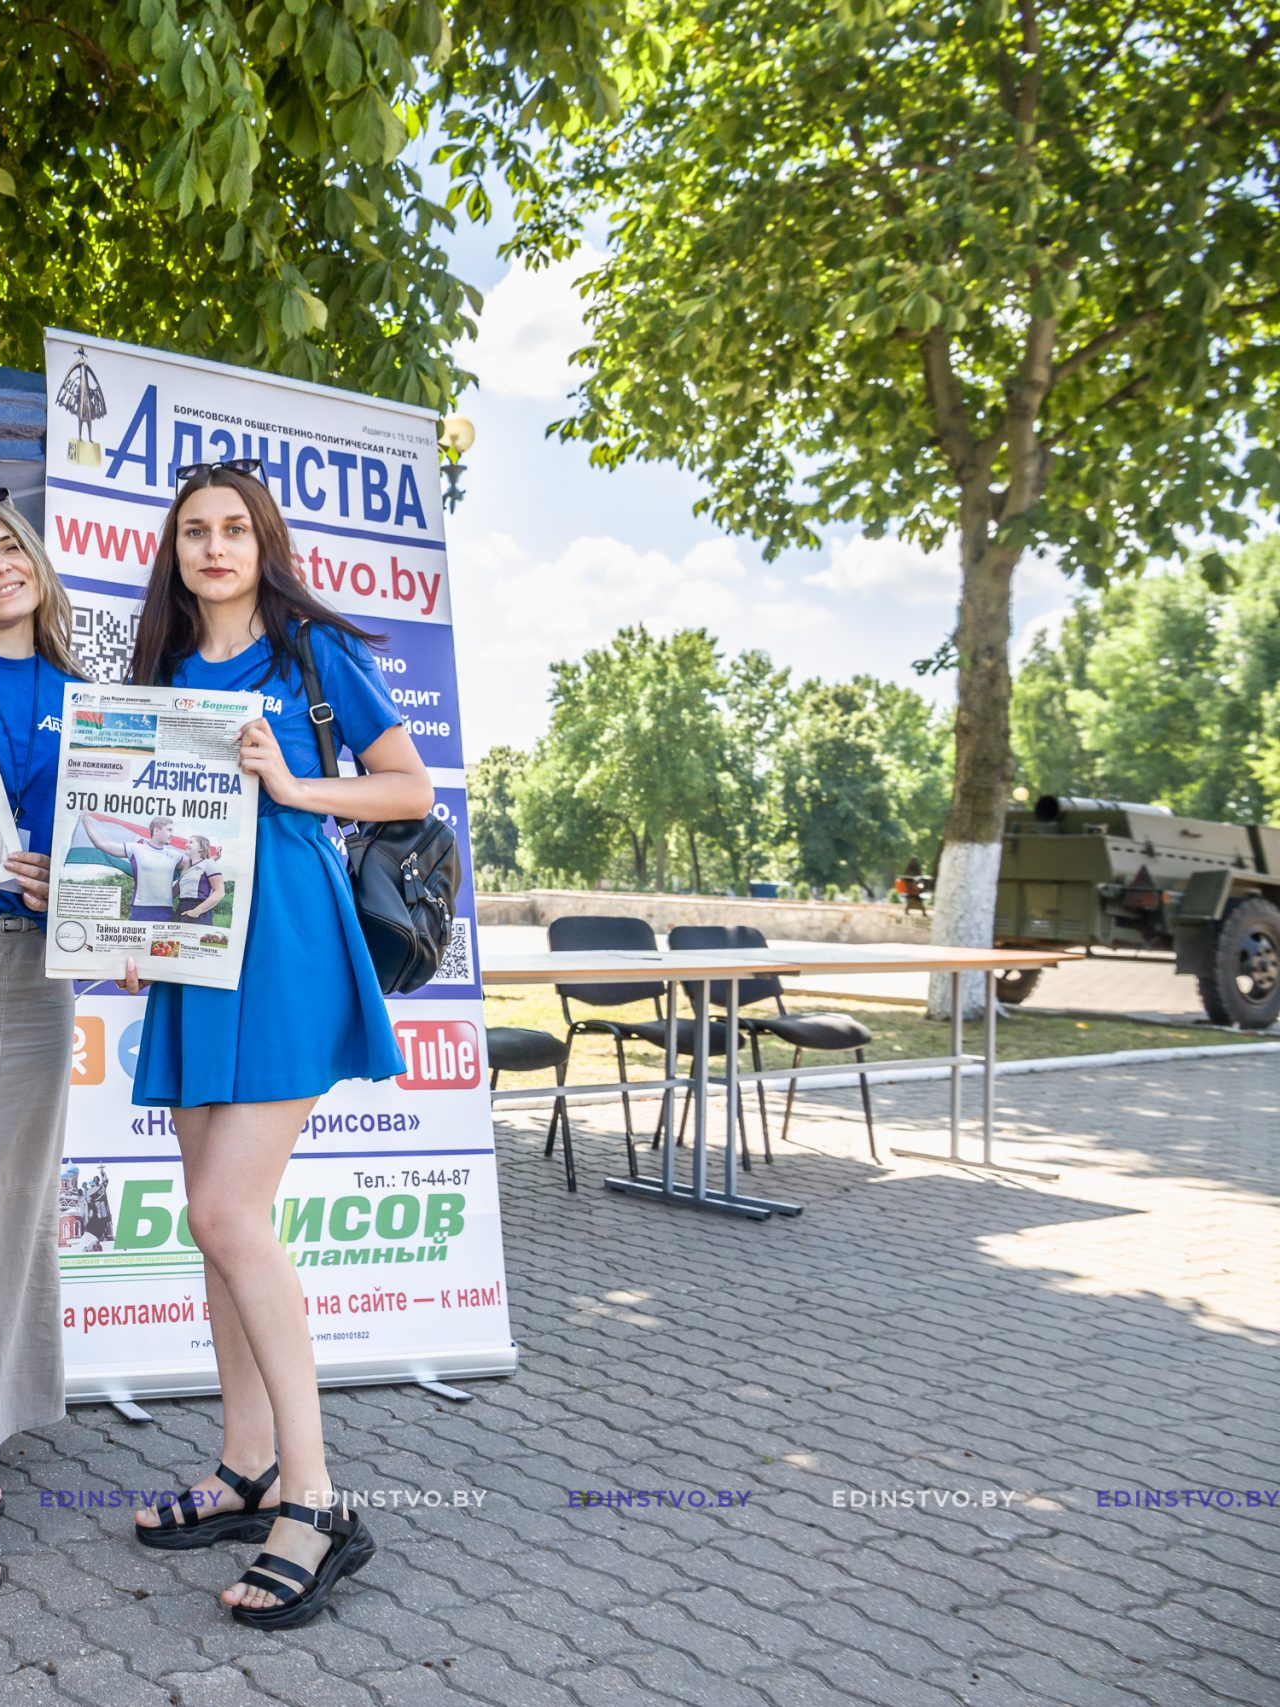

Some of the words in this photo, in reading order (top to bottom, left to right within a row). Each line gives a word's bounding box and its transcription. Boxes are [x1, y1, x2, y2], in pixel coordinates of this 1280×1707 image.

[173, 404, 242, 425] БОРИСОВСКАЯ
[244, 419, 384, 453] ОБЩЕСТВЕННО-ПОЛИТИЧЕСКАЯ
[386, 448, 418, 460] ГАЗЕТА
[390, 688, 441, 708] одит
[67, 759, 81, 768] Они
[82, 760, 124, 771] поженились
[156, 761, 207, 771] edinstvo.by
[132, 759, 242, 795] АДЗІНСТВА
[66, 791, 98, 811] ЭТО
[104, 794, 176, 817] ЮНОСТЬ
[182, 799, 228, 821] МОЯ!
[95, 923, 120, 935] Тайны
[122, 926, 147, 935] наших
[353, 1171, 396, 1189] Тел.:
[401, 1168, 471, 1188] 76-44-87
[83, 1295, 195, 1334] рекламой
[317, 1293, 342, 1316] на
[347, 1286, 408, 1314] сайте
[441, 1289, 452, 1309] к
[457, 1280, 502, 1309] нам!
[316, 1333, 332, 1342] УНП
